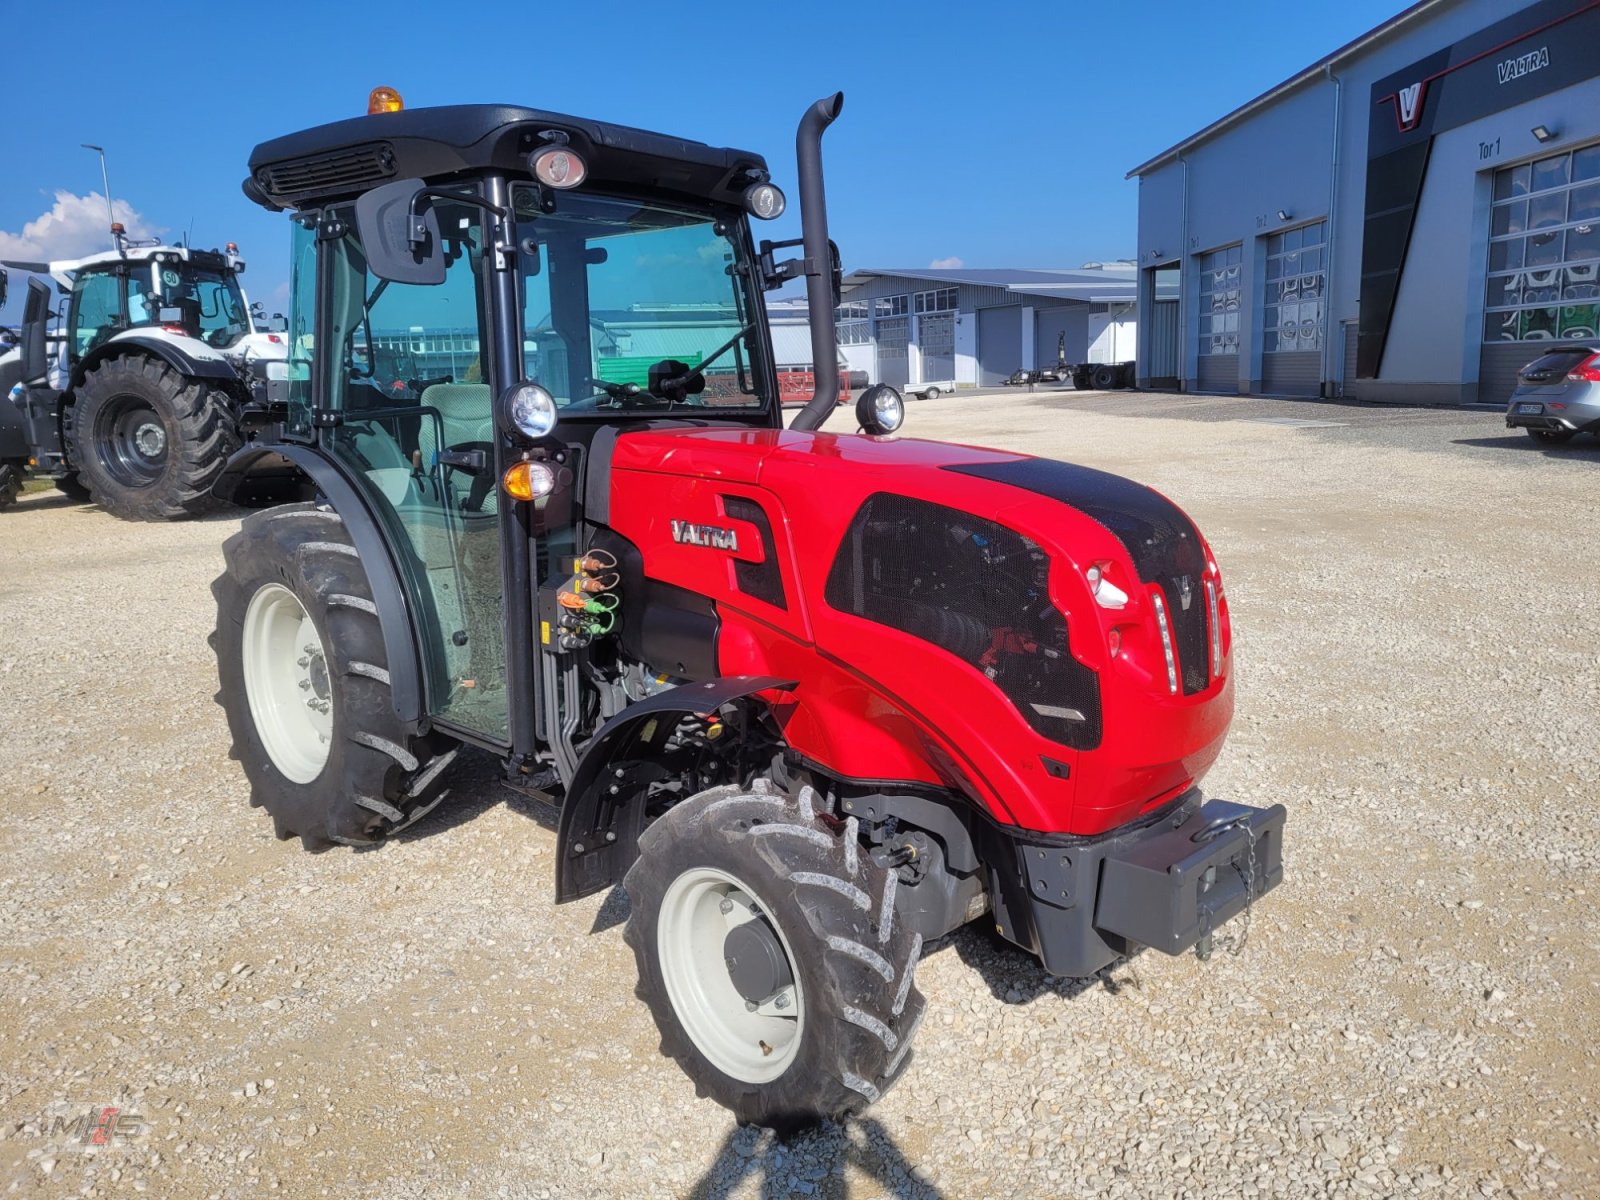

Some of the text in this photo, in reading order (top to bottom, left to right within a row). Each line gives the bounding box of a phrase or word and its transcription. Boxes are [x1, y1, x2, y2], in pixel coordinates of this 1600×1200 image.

[1498, 47, 1549, 84] VALTRA
[1479, 136, 1501, 160] Tor 1
[165, 272, 177, 285] 50
[671, 519, 738, 552] VALTRA
